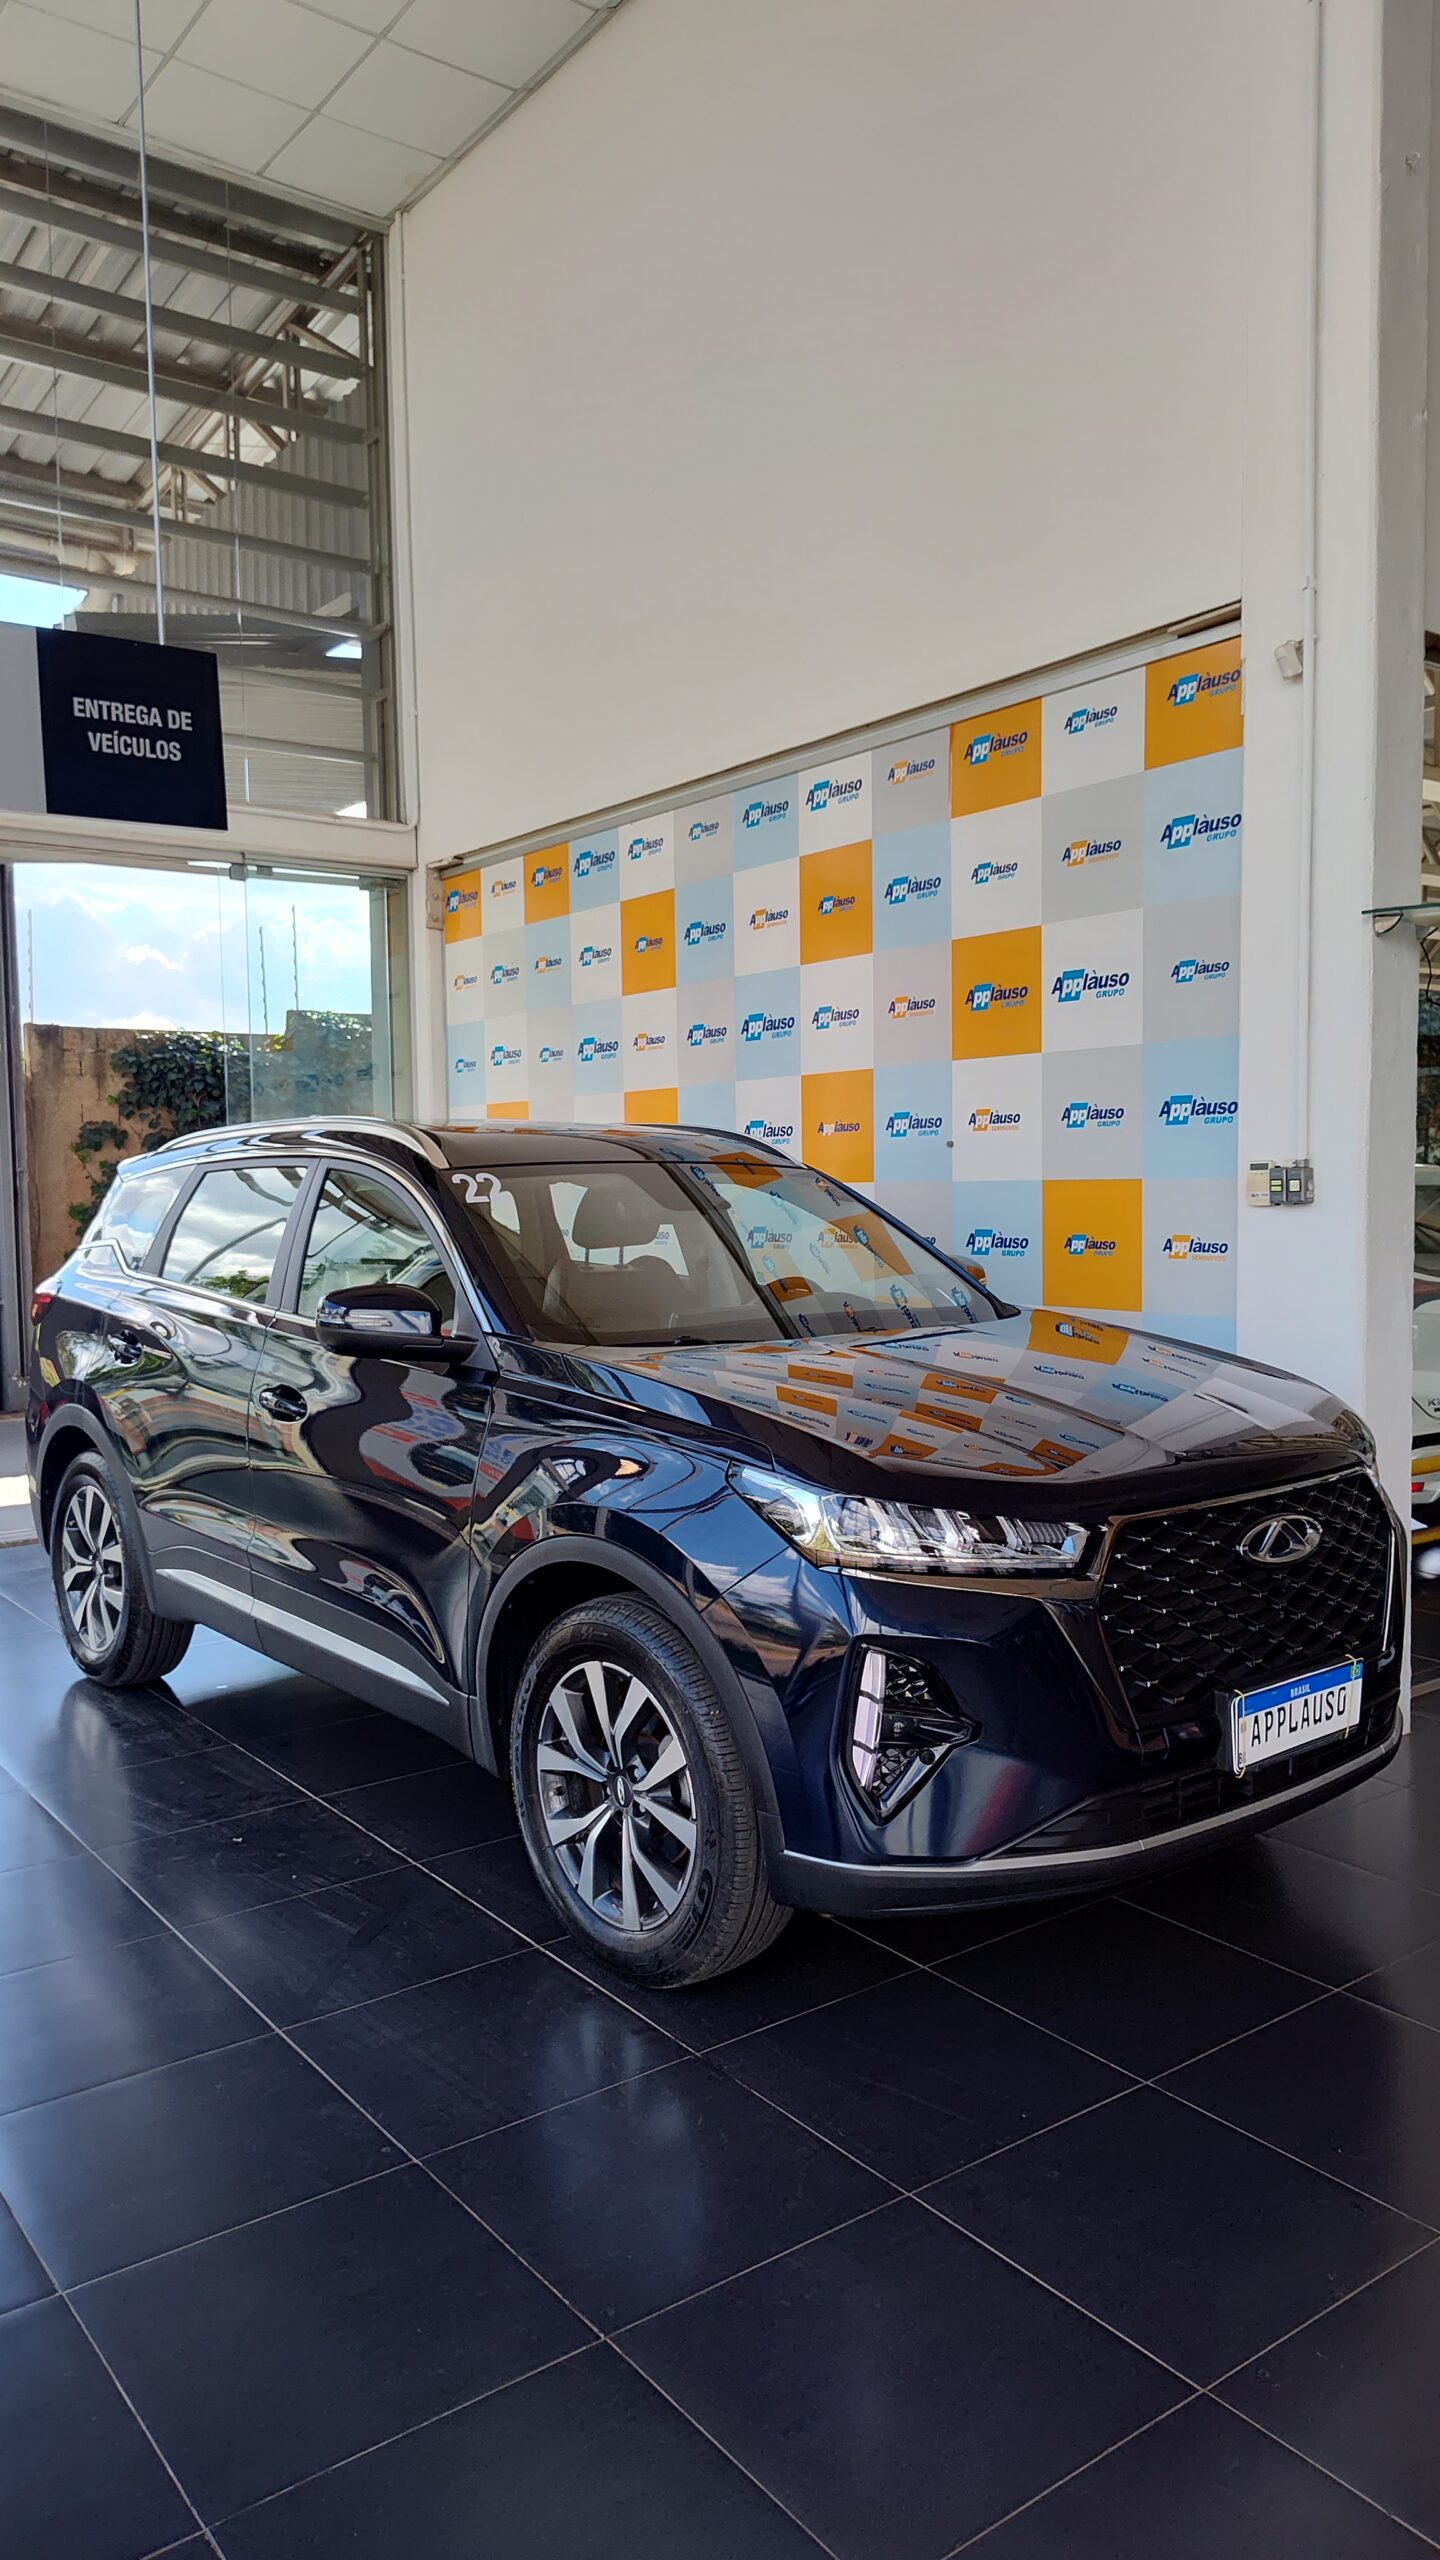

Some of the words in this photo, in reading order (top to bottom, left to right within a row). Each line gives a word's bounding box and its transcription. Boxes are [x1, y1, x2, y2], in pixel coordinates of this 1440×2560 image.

[1208, 684, 1237, 698] GRUPO
[73, 696, 163, 728] ENTREGA
[167, 709, 193, 731] DE
[1094, 718, 1115, 728] GRUPO
[87, 730, 182, 761] VEÍCULOS
[1000, 745, 1025, 758] GRUPO
[838, 792, 859, 805] GRUPO
[1206, 830, 1237, 842] GRUPO
[997, 871, 1016, 881] GRUPO
[916, 890, 938, 900] GRUPO
[1204, 972, 1226, 981] GRUPO
[1096, 988, 1125, 999] GRUPO
[1000, 999, 1025, 1009] GRUPO
[771, 1030, 792, 1039] GRUPO
[1097, 1120, 1121, 1128] GRUPO
[1204, 1115, 1234, 1125] GRUPO
[918, 1129, 940, 1137] GRUPO
[771, 1137, 791, 1145] GRUPO
[452, 1172, 512, 1204] 22
[1290, 1684, 1311, 1698] BRASIL
[1251, 1686, 1347, 1748] APPLAUSO
